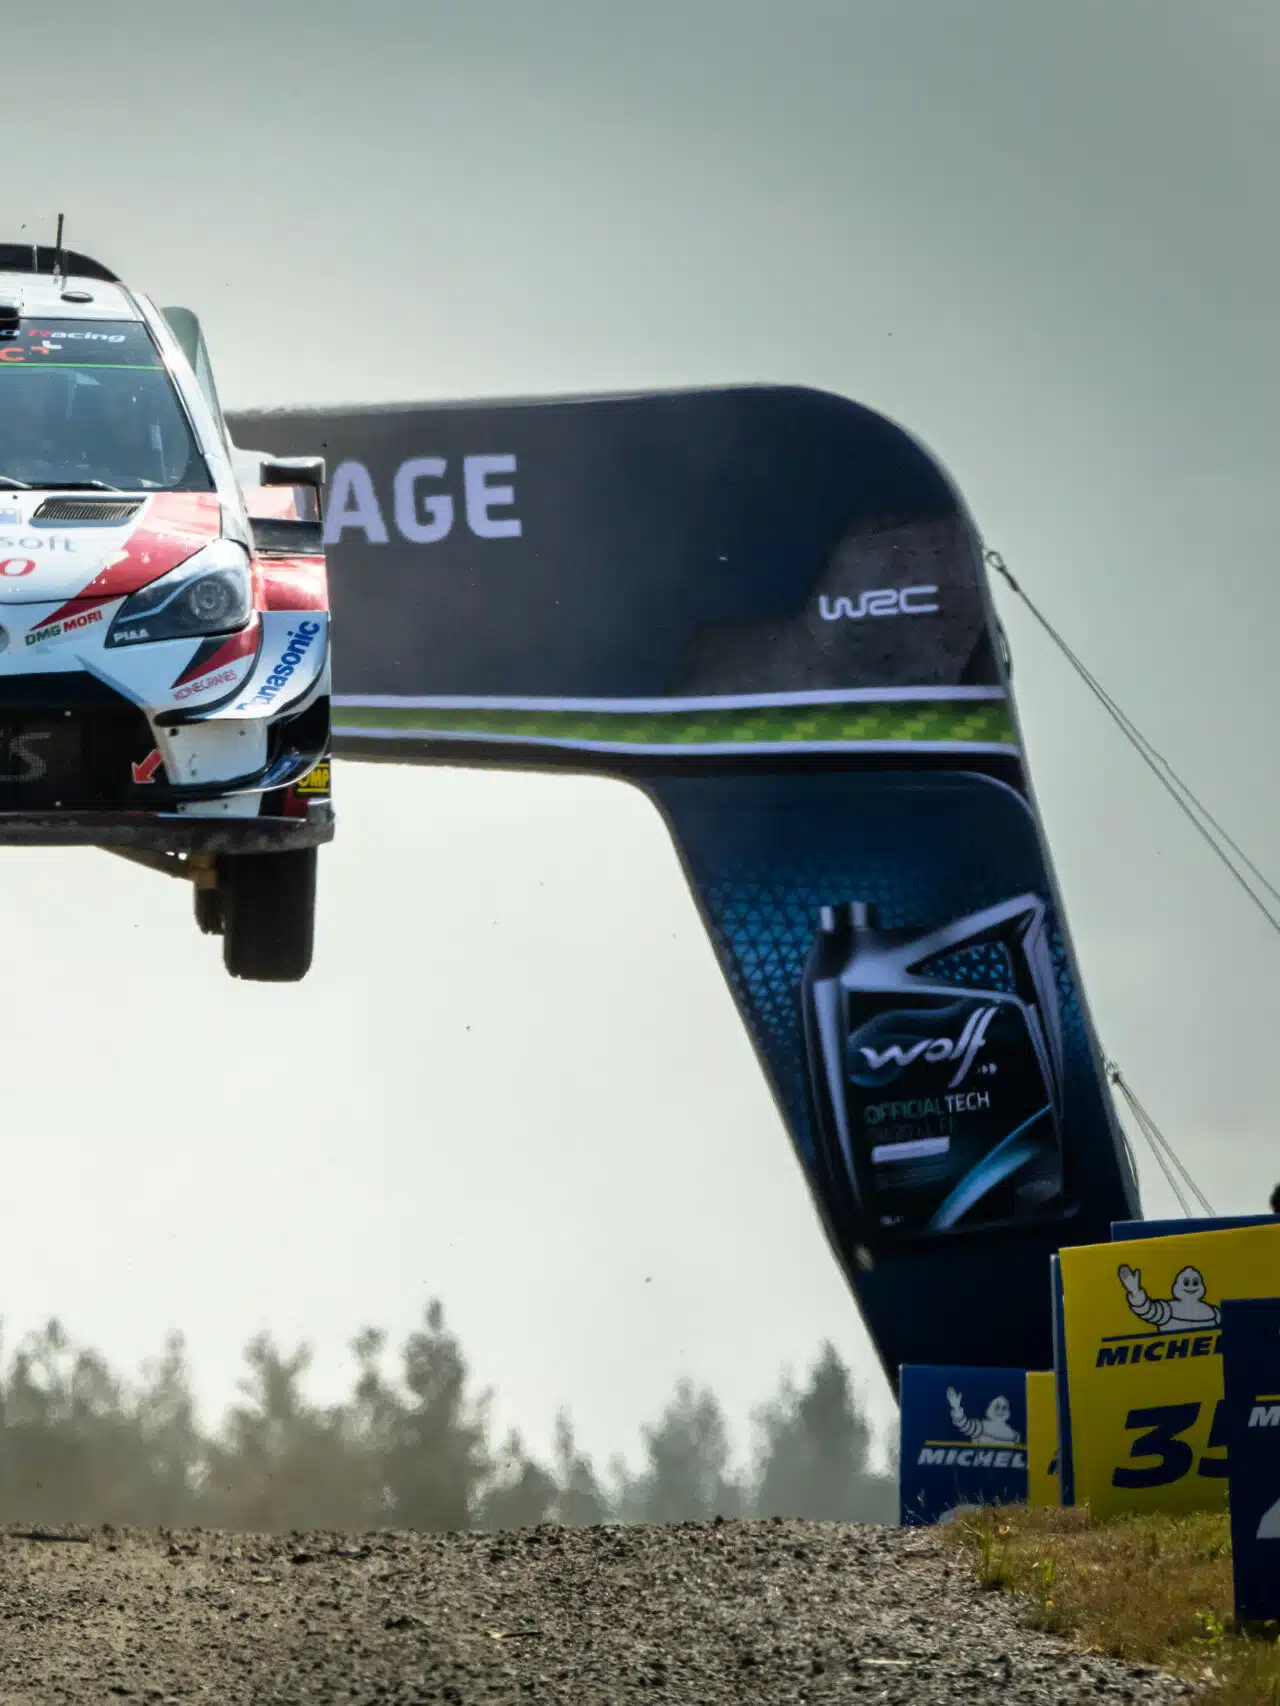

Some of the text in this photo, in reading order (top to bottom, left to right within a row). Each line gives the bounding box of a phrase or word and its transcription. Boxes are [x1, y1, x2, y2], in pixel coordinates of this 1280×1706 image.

[28, 329, 126, 343] Racing
[323, 454, 521, 544] AGE
[818, 585, 939, 621] WRC
[24, 610, 103, 647] DMG MORI
[113, 628, 149, 643] PIAA
[860, 1007, 1000, 1088] wolf
[944, 1090, 991, 1113] TECH
